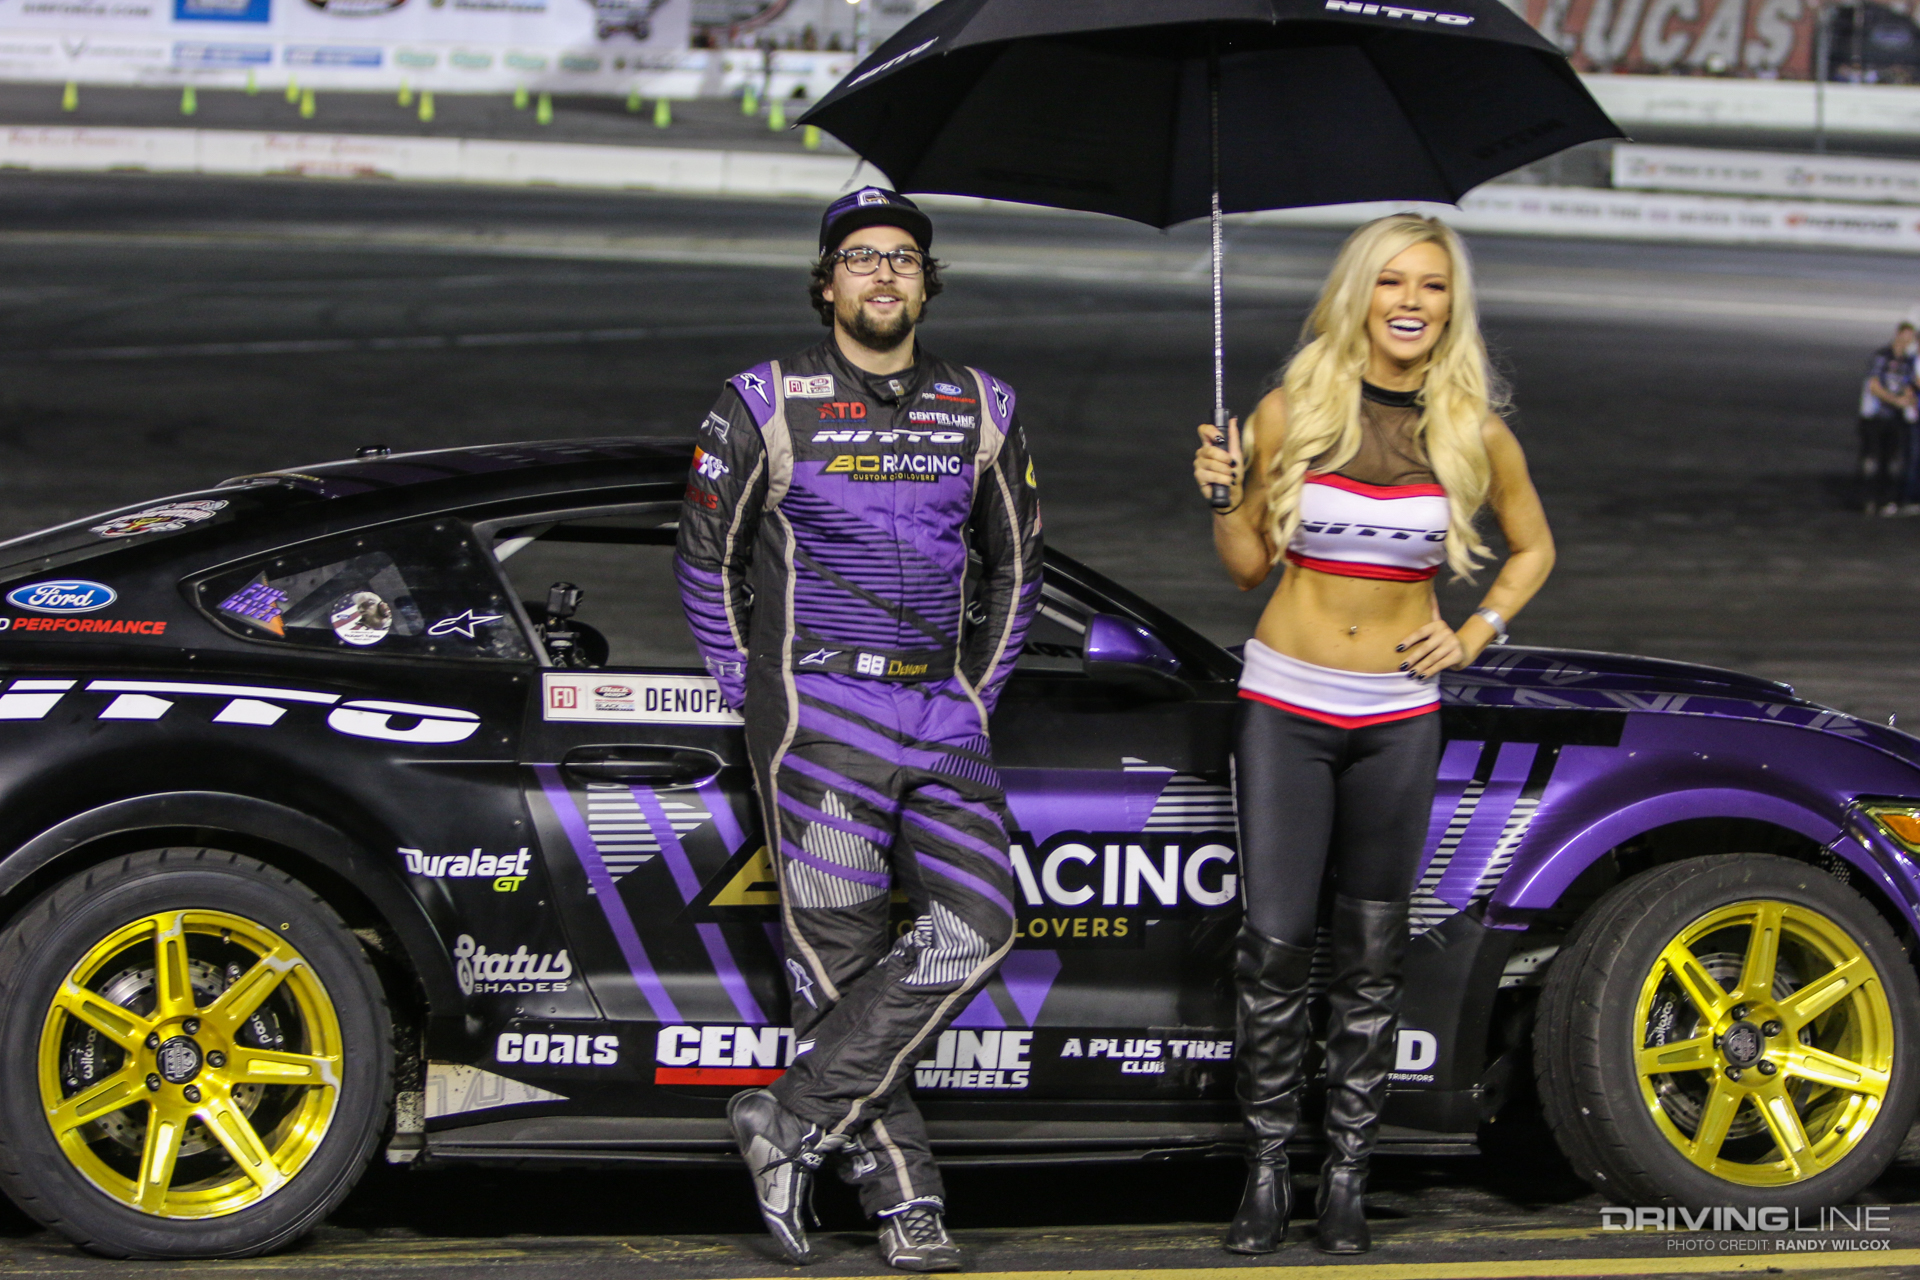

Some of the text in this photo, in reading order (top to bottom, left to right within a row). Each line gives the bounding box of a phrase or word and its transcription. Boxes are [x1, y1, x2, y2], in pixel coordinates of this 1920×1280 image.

[1325, 0, 1474, 26] NITTO
[816, 401, 867, 420] ATD
[811, 428, 965, 443] NITTO
[824, 453, 962, 475] BC RACING
[852, 473, 887, 482] CUSTOM
[28, 584, 96, 607] Ford
[12, 617, 168, 635] PERFORMANCE
[856, 652, 886, 677] 88
[553, 688, 574, 707] FD
[0, 679, 482, 744] ITTO
[397, 846, 532, 878] Duralast
[492, 876, 527, 893] GT
[1009, 843, 1238, 907] ACING
[1014, 917, 1130, 938] LOVERS
[454, 934, 573, 995] Status
[474, 982, 570, 993] SHADES
[81, 1028, 98, 1080] wilwoo
[655, 1025, 1035, 1070] CENT INE
[1060, 1038, 1084, 1058] A
[1088, 1038, 1163, 1059] PLUS
[914, 1069, 1031, 1090] WHEELS
[1387, 1072, 1435, 1083] TRIBUTORS
